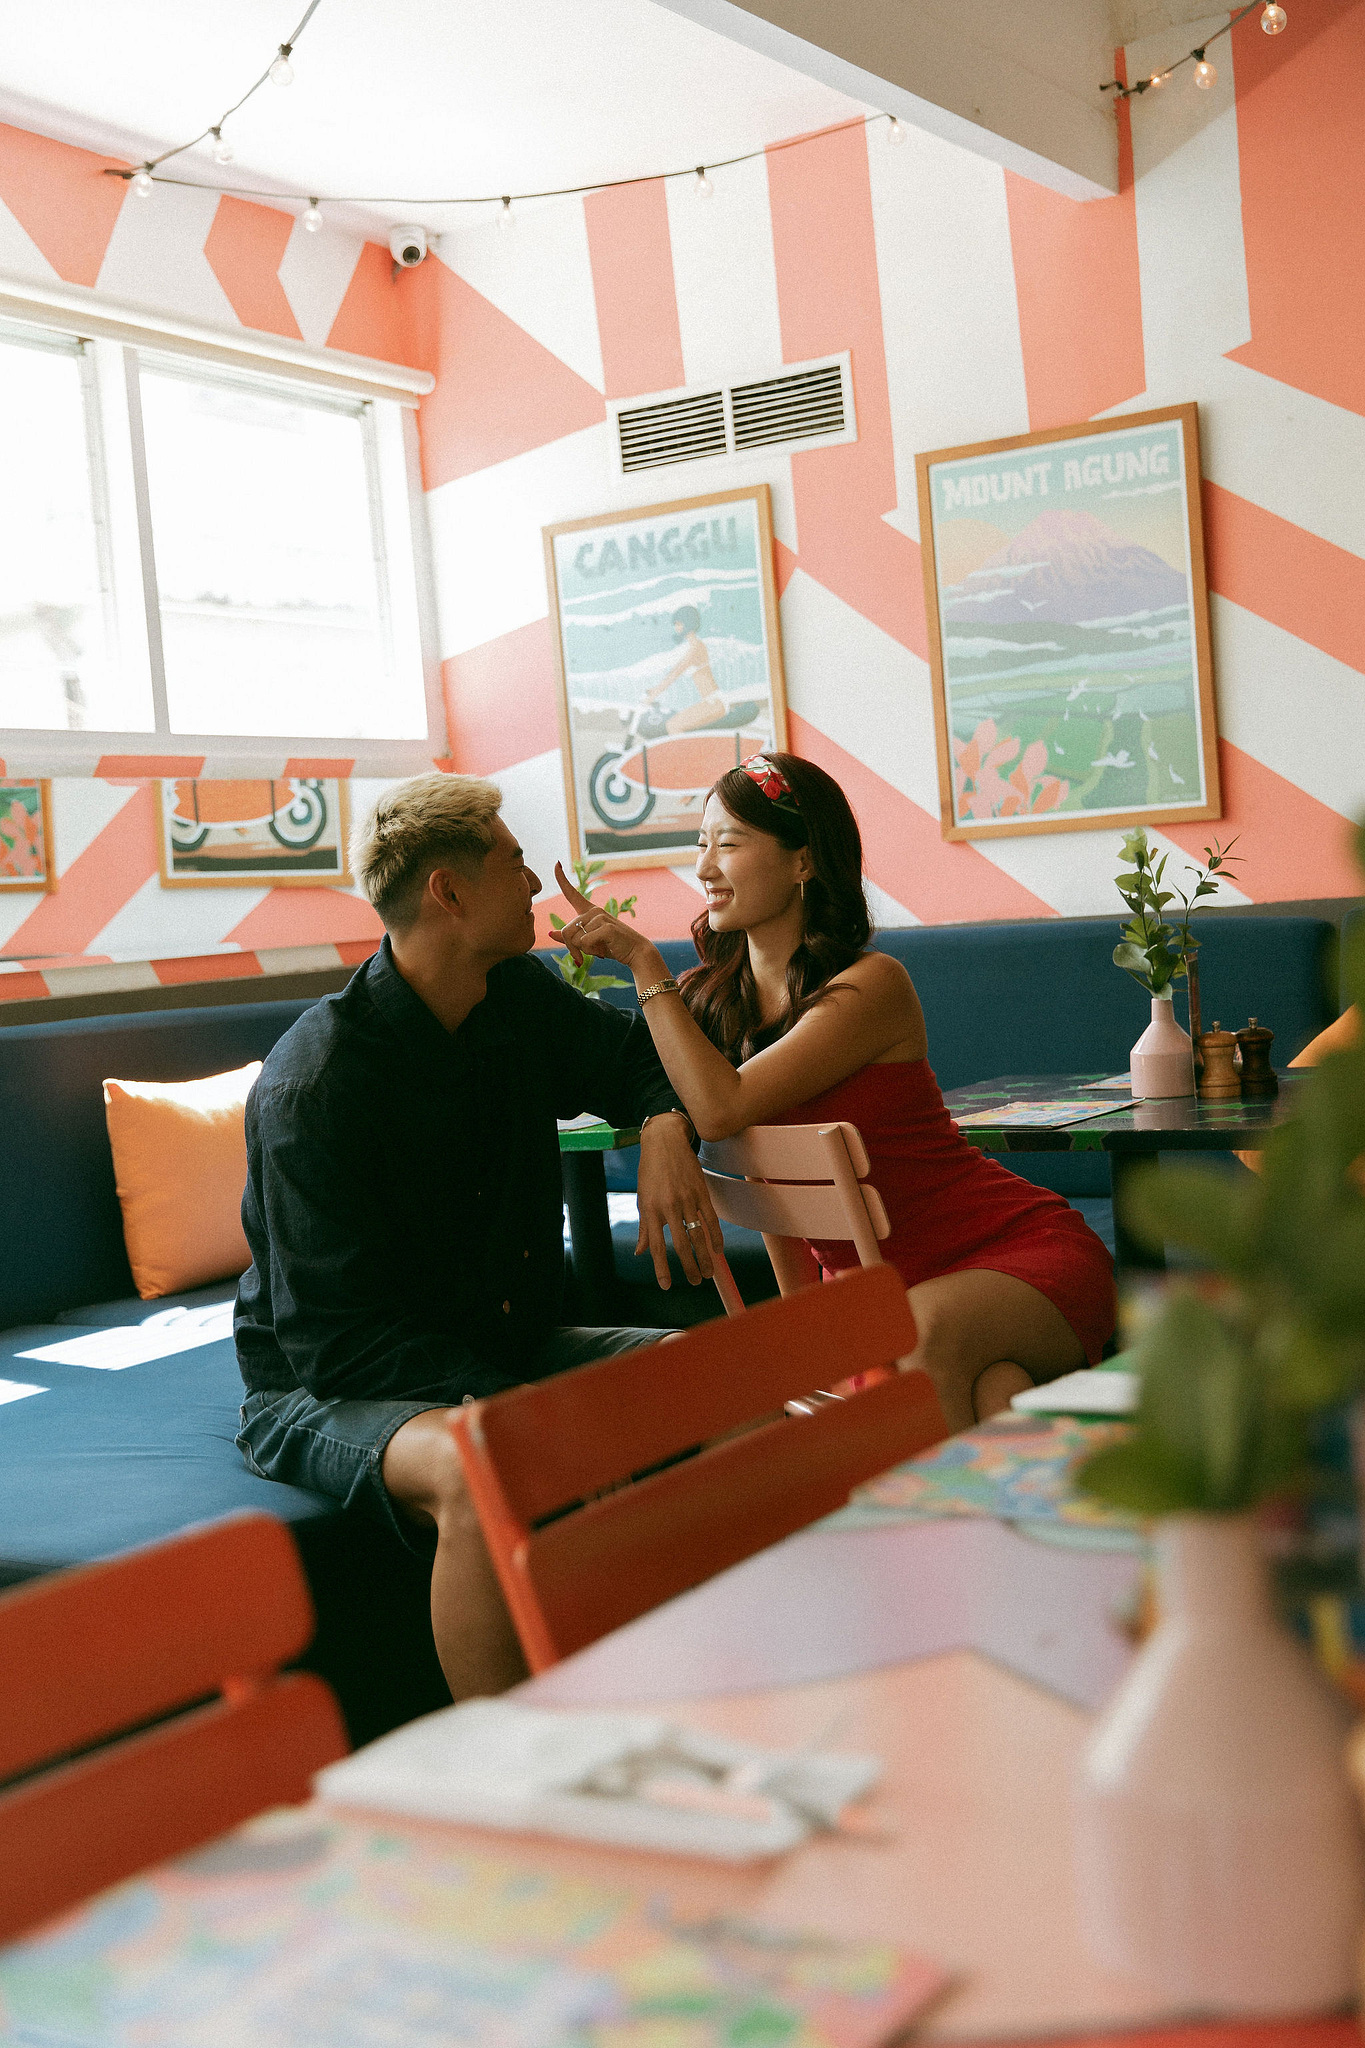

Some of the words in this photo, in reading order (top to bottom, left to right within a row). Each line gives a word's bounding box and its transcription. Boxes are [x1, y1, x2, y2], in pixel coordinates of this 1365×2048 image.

[942, 462, 1052, 511] MOUNT
[1063, 443, 1170, 492] AGUNG
[574, 517, 738, 579] CANGGU
